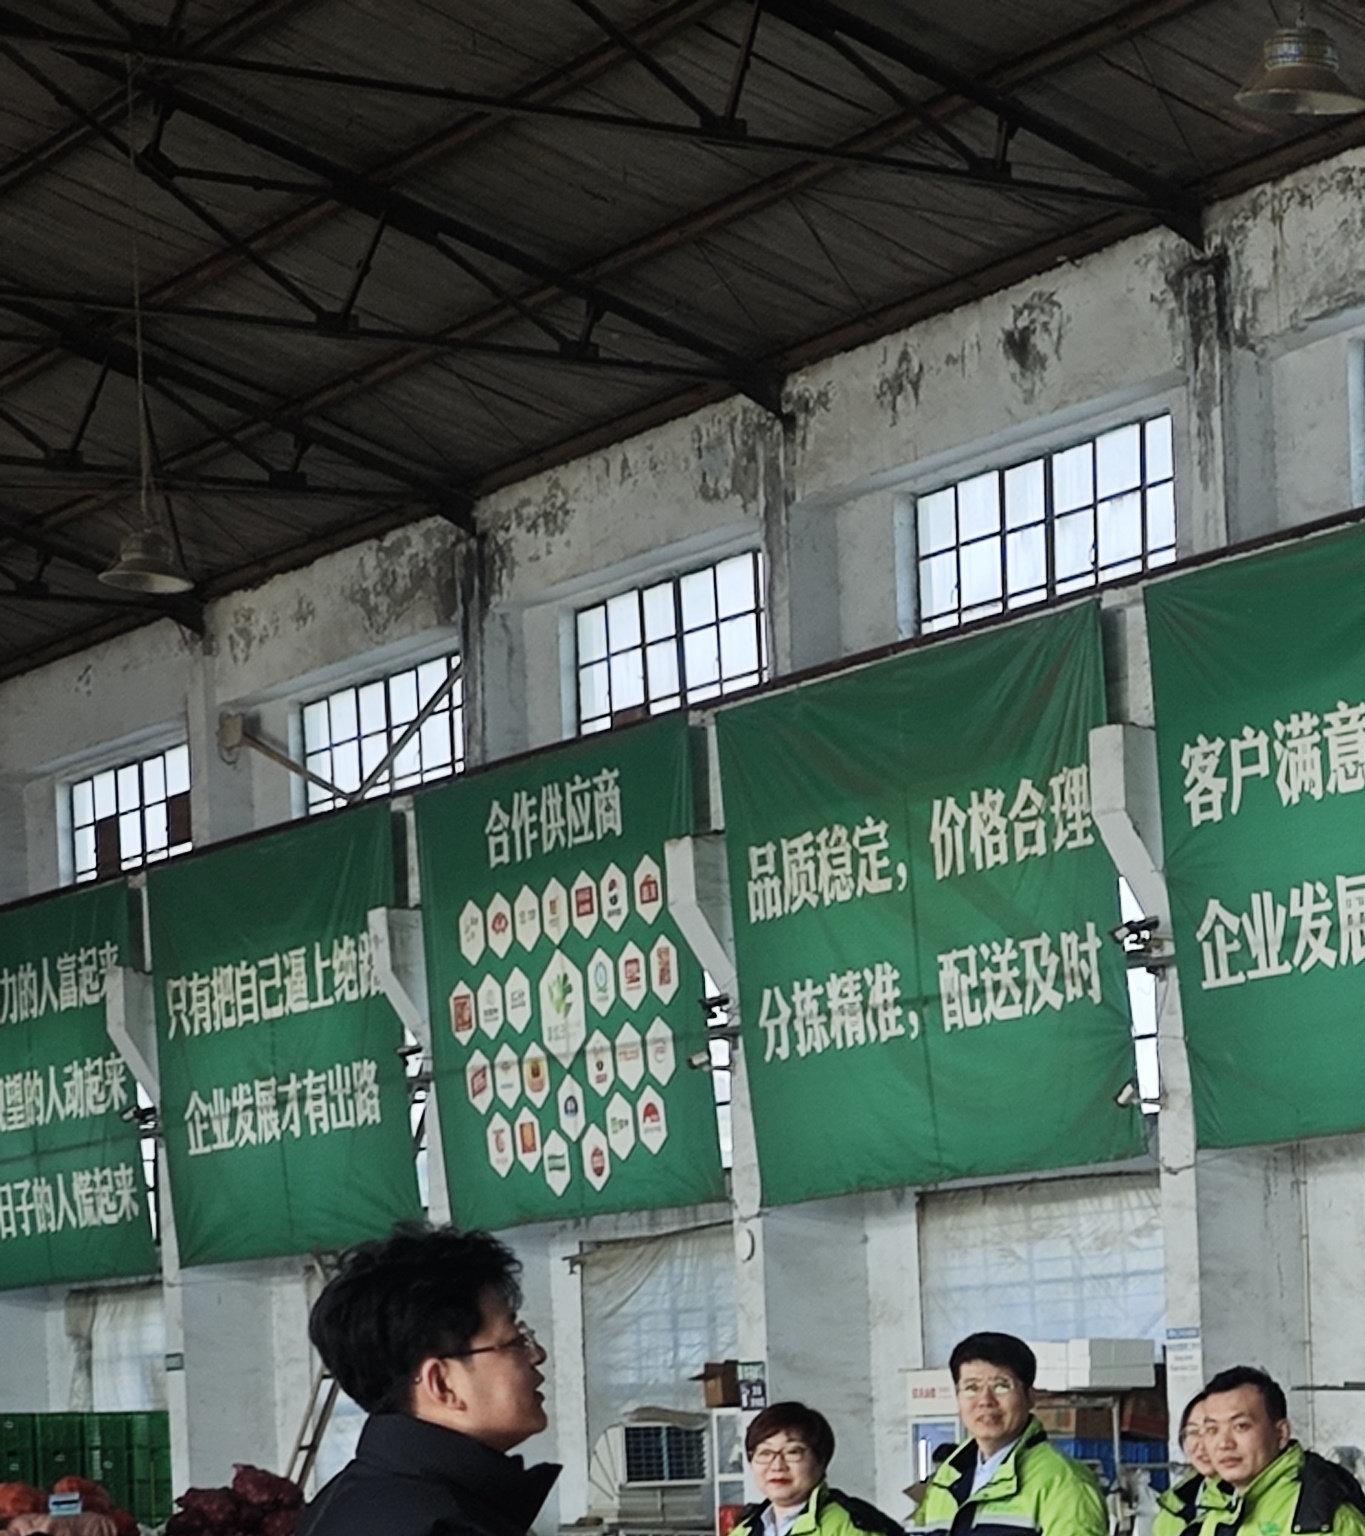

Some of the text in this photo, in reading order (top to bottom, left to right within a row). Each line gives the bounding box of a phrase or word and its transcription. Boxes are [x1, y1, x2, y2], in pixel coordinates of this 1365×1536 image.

[484, 767, 624, 869] 合作供应商
[747, 765, 1097, 923] 品质稳定，价格合理
[0, 1052, 129, 1132] 望的人动起来
[184, 1058, 383, 1156] 企业发展才有出路
